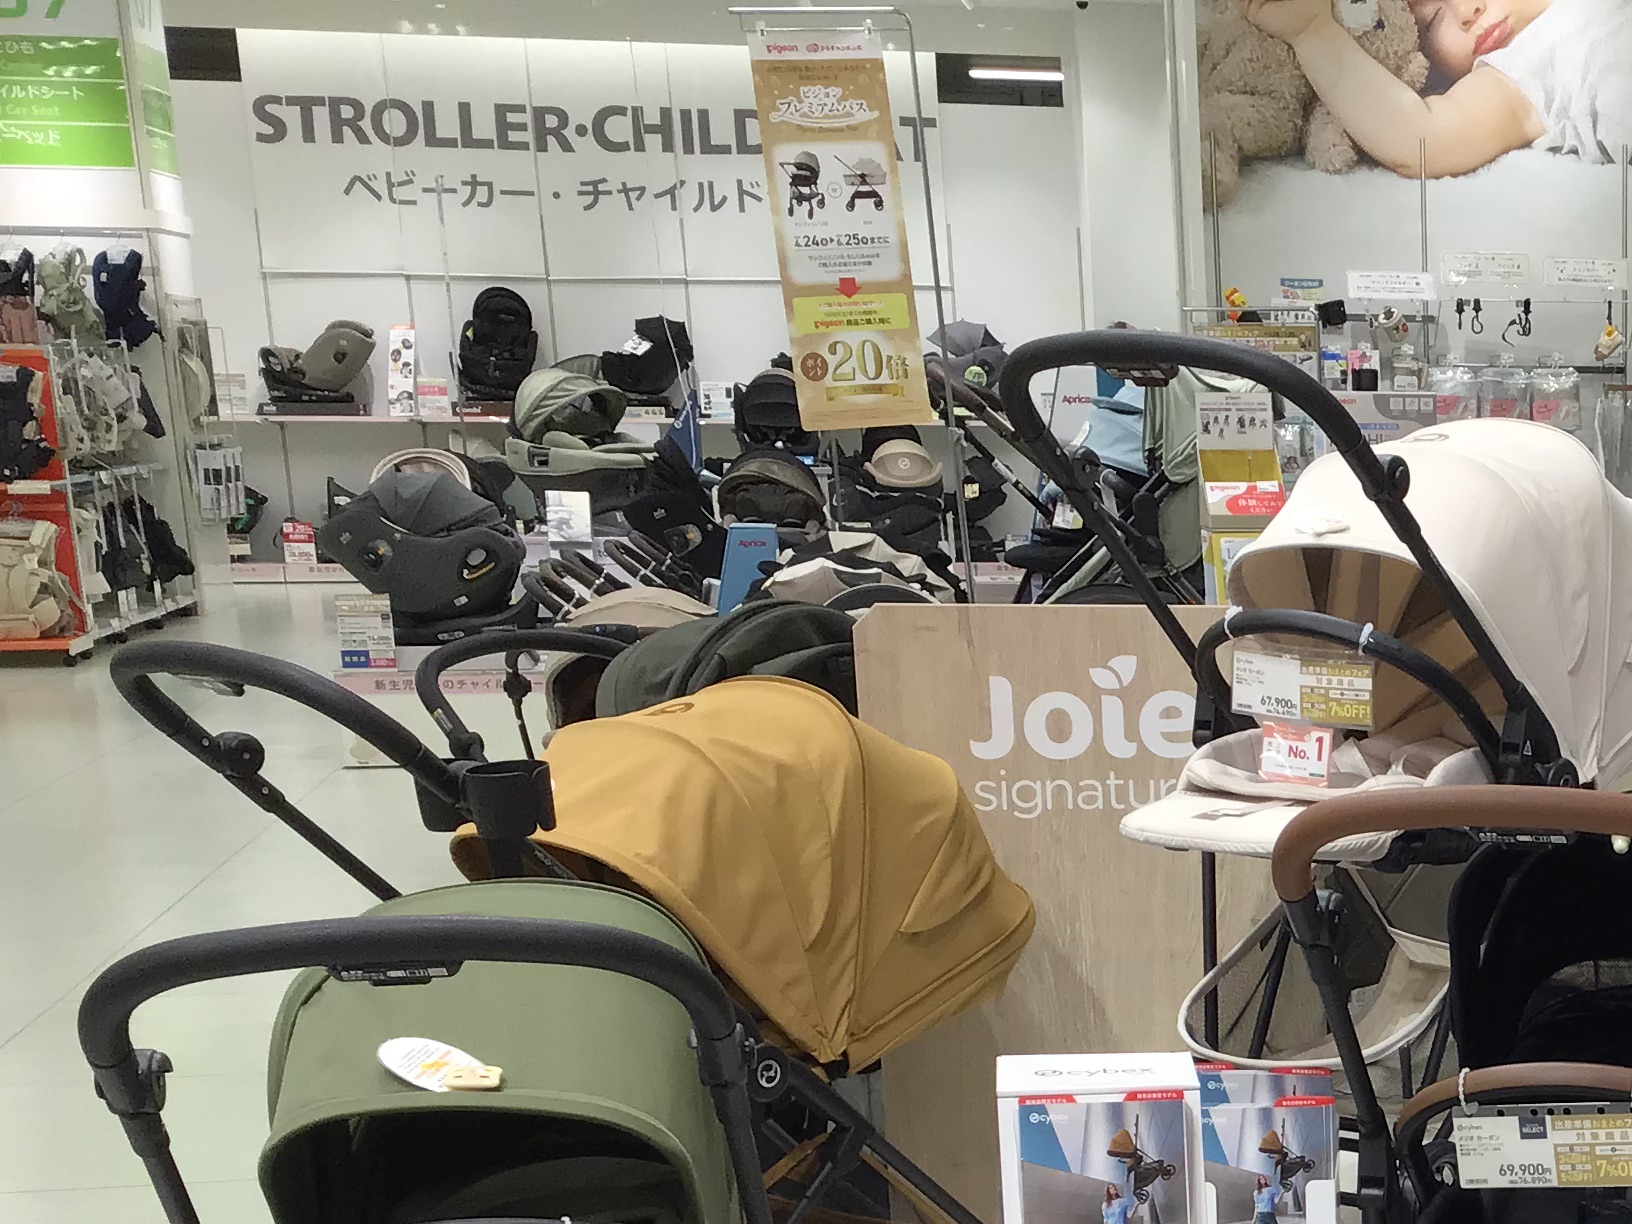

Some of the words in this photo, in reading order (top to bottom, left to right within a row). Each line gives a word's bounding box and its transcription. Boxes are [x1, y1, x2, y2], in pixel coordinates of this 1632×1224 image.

[1062, 394, 1092, 405] Aprica
[970, 655, 1198, 760] Joie
[1288, 744, 1310, 761] No.
[1499, 1163, 1552, 1177] 69,900円
